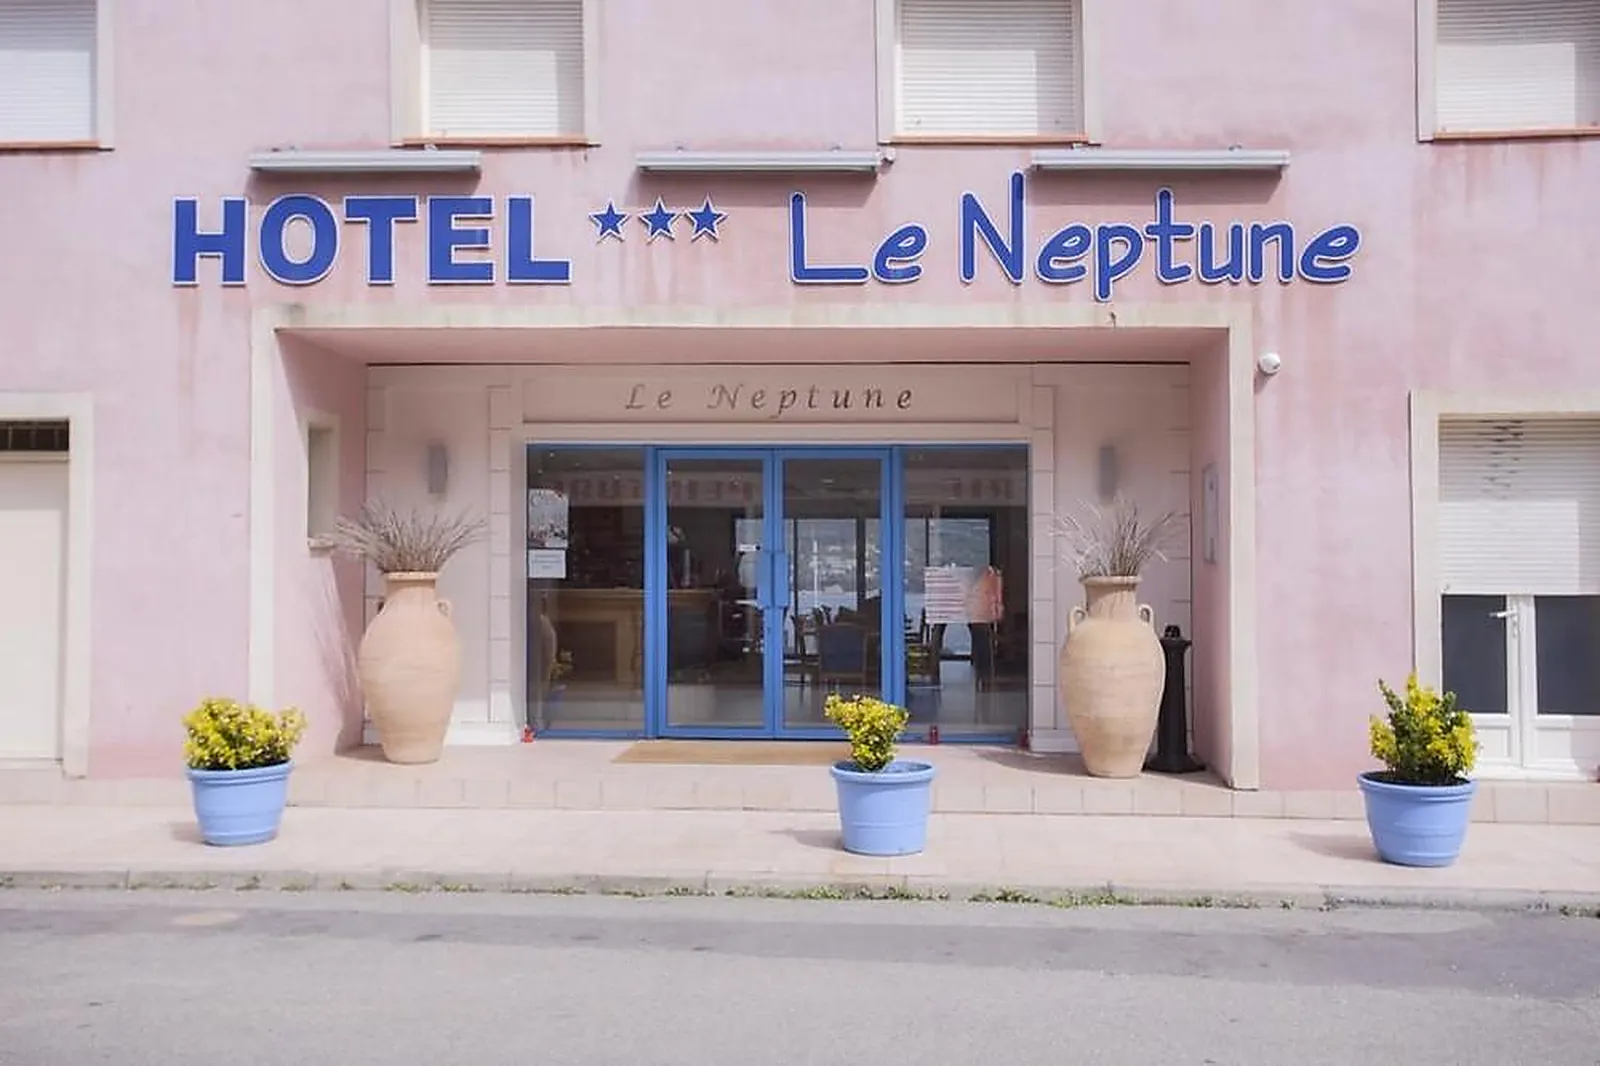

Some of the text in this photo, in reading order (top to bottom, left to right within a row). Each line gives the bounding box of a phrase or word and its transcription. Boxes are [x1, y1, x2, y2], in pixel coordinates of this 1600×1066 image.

[172, 170, 1362, 301] HOTEL Le Neptune
[624, 383, 913, 419] Le Neptune
